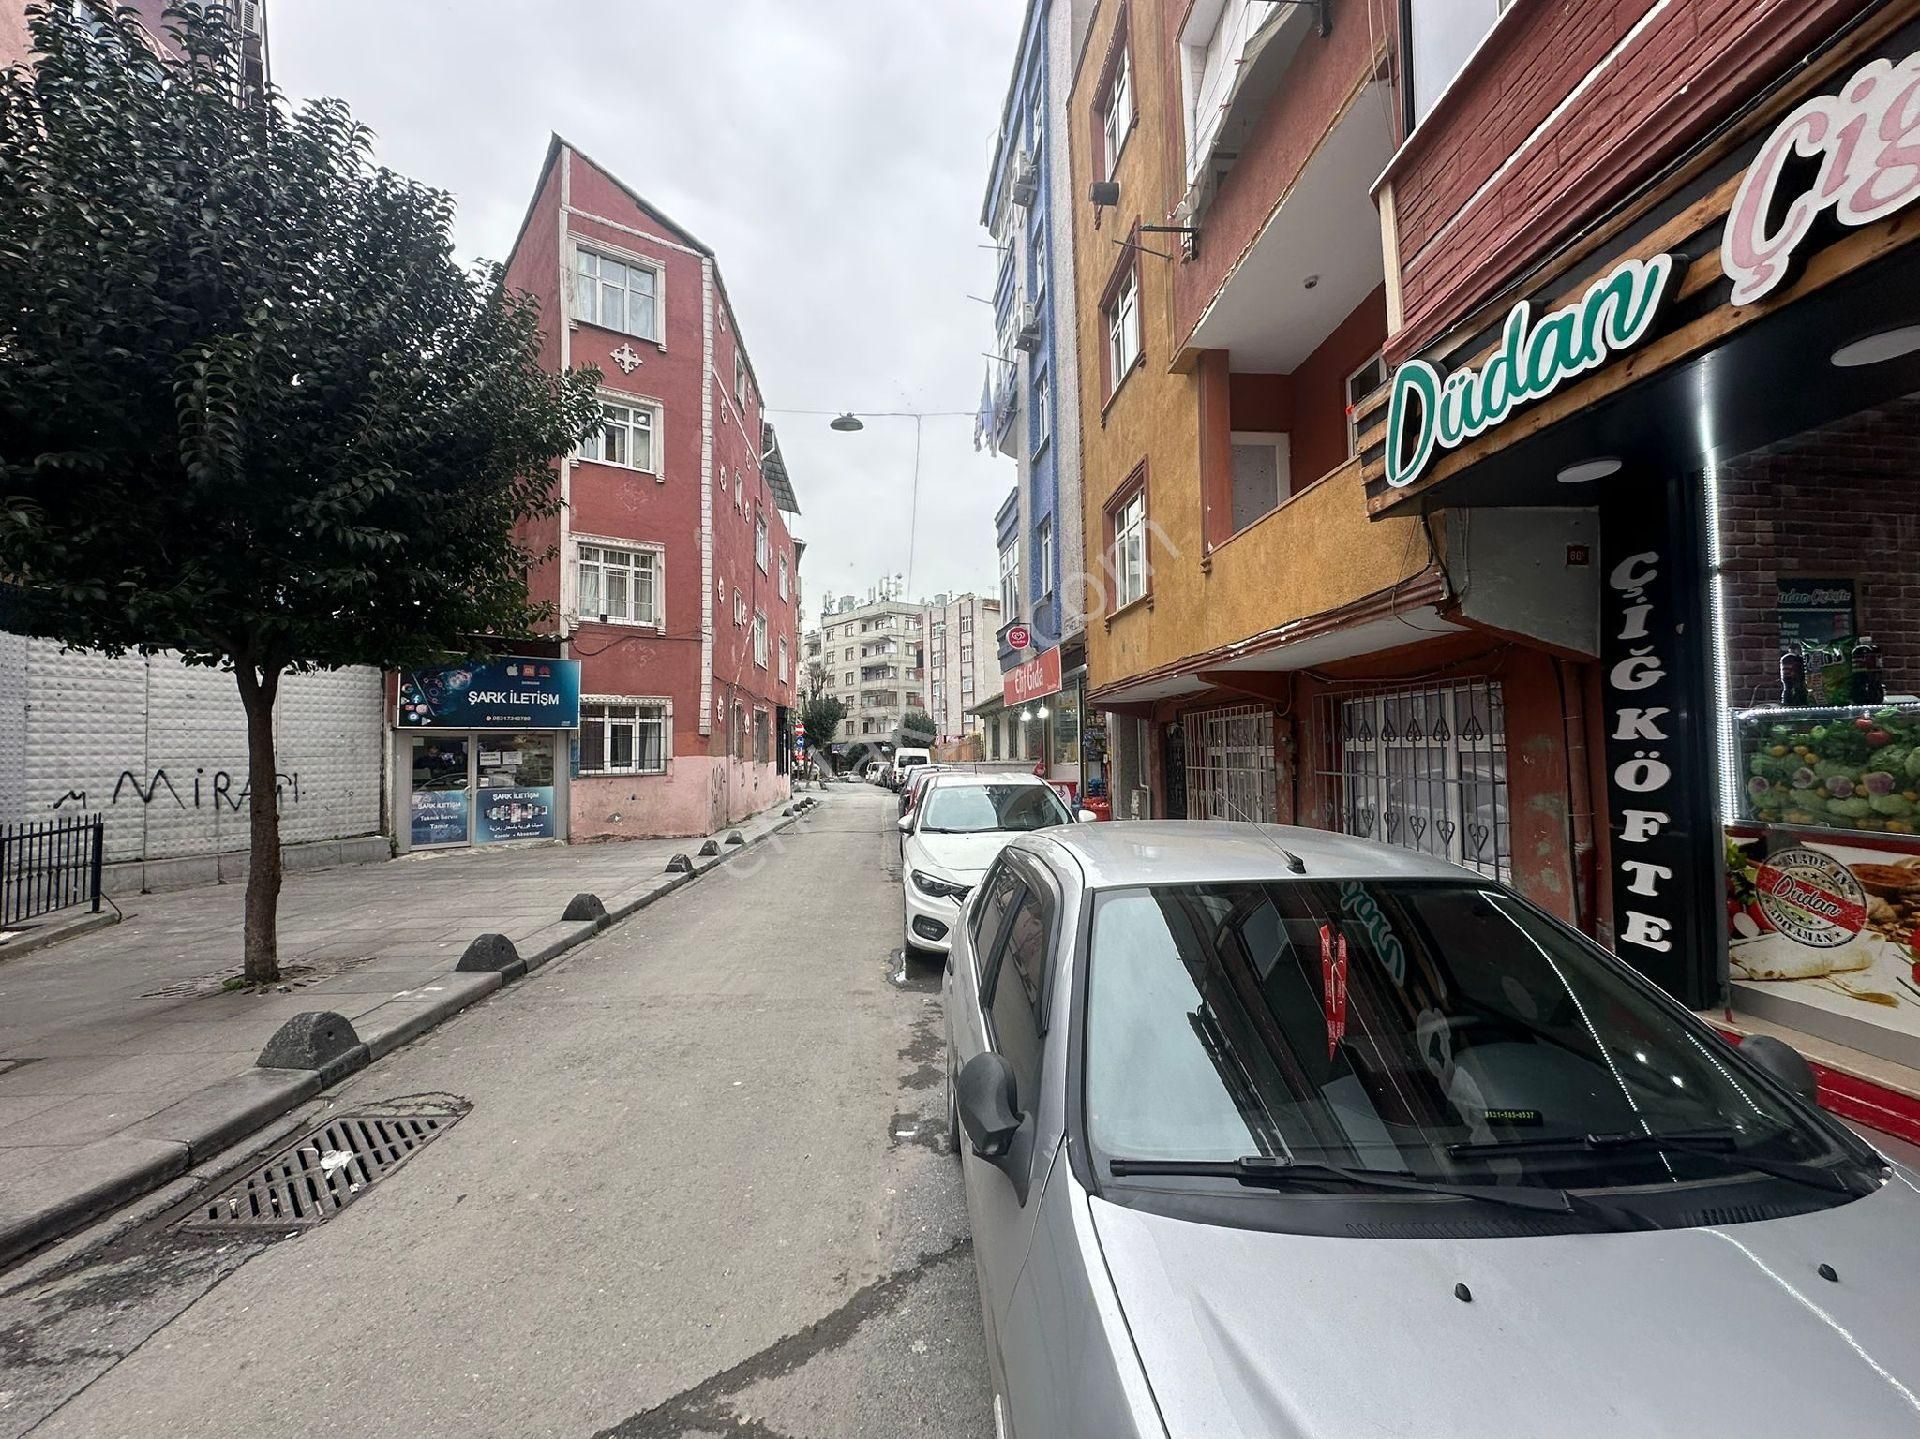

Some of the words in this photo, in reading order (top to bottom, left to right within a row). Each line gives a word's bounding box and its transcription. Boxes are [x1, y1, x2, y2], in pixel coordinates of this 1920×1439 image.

[1386, 255, 1670, 486] Düdan
[468, 691, 507, 706] ŞARK
[1786, 853, 1829, 870] MADE
